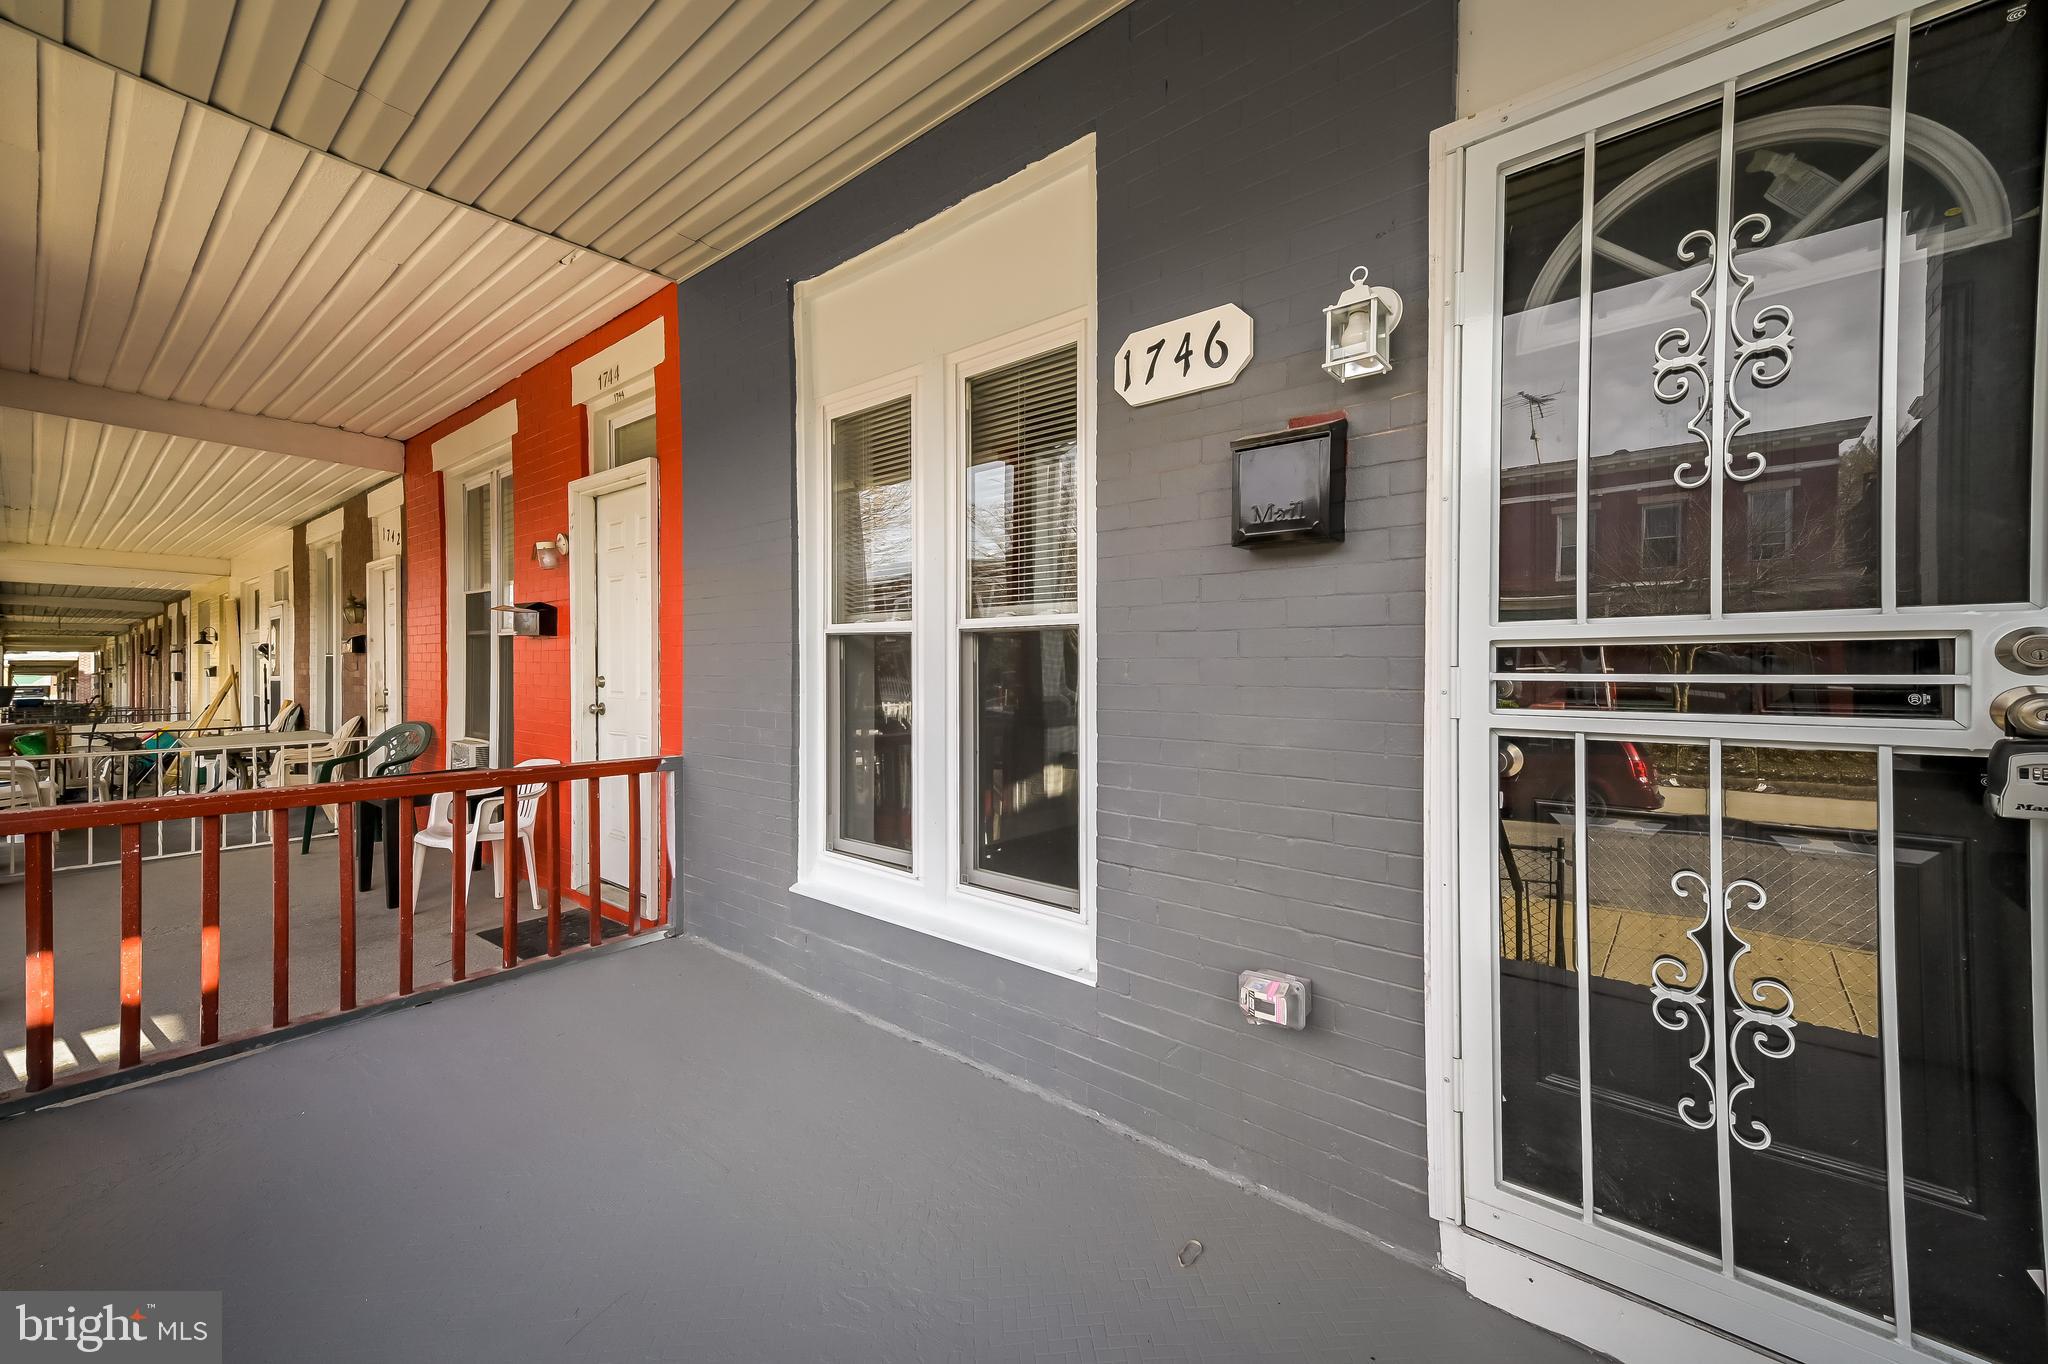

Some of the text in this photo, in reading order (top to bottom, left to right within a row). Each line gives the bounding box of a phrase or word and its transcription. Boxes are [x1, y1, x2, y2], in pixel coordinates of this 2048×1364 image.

[1123, 320, 1229, 392] 1746
[598, 364, 620, 390] 1744
[613, 390, 625, 402] 1744
[1251, 500, 1304, 526] Mail
[382, 527, 401, 546] 1742
